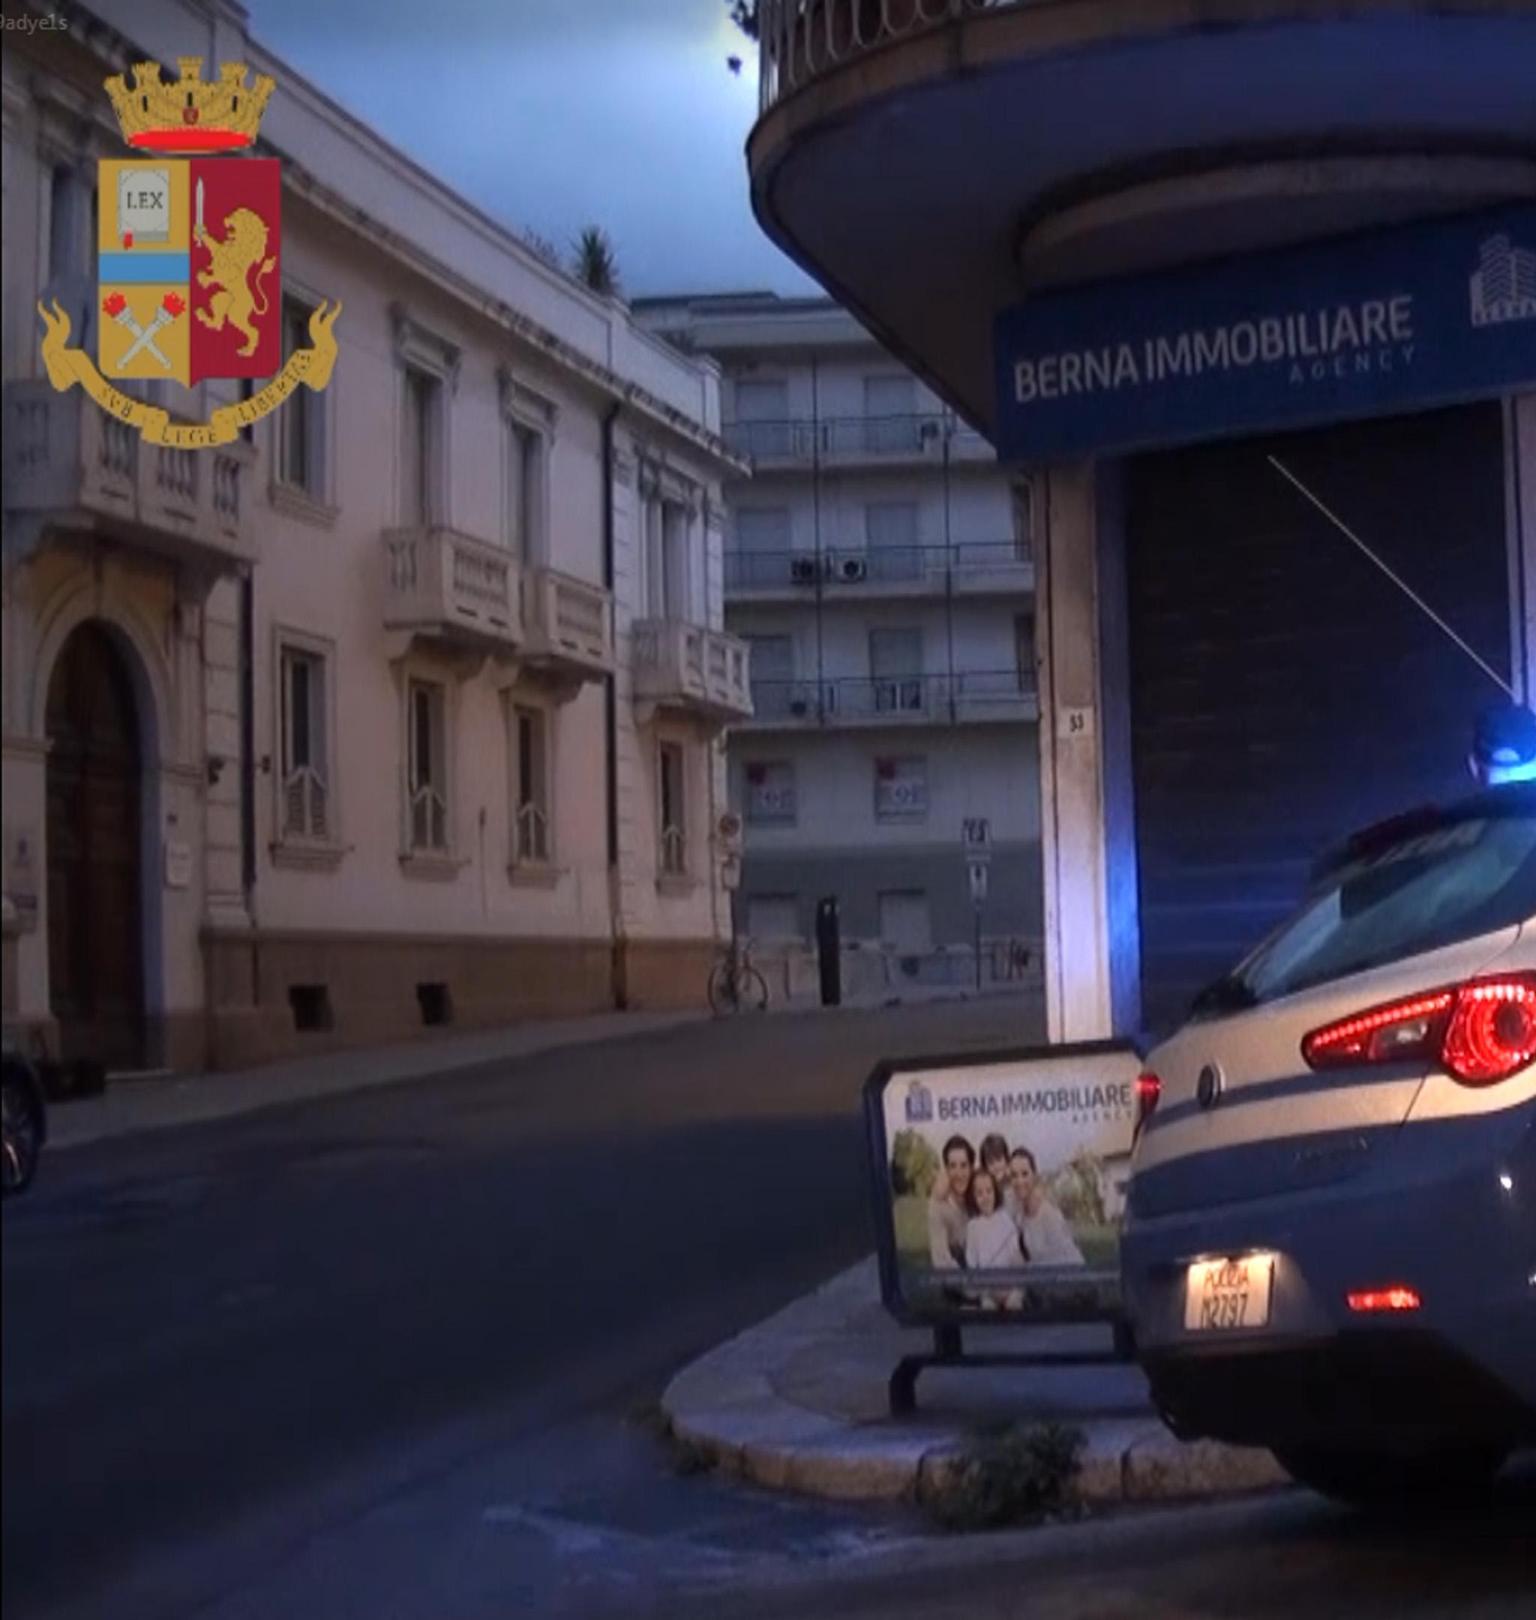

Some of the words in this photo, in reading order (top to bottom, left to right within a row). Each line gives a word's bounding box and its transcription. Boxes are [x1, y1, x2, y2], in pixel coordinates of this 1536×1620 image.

[1014, 344, 1140, 402] BERNA
[1144, 296, 1413, 380] IMMOBILIARE
[1289, 345, 1416, 384] AGENCY
[938, 1096, 999, 1122] BERNA
[1001, 1084, 1132, 1117] IMMOBILIARE
